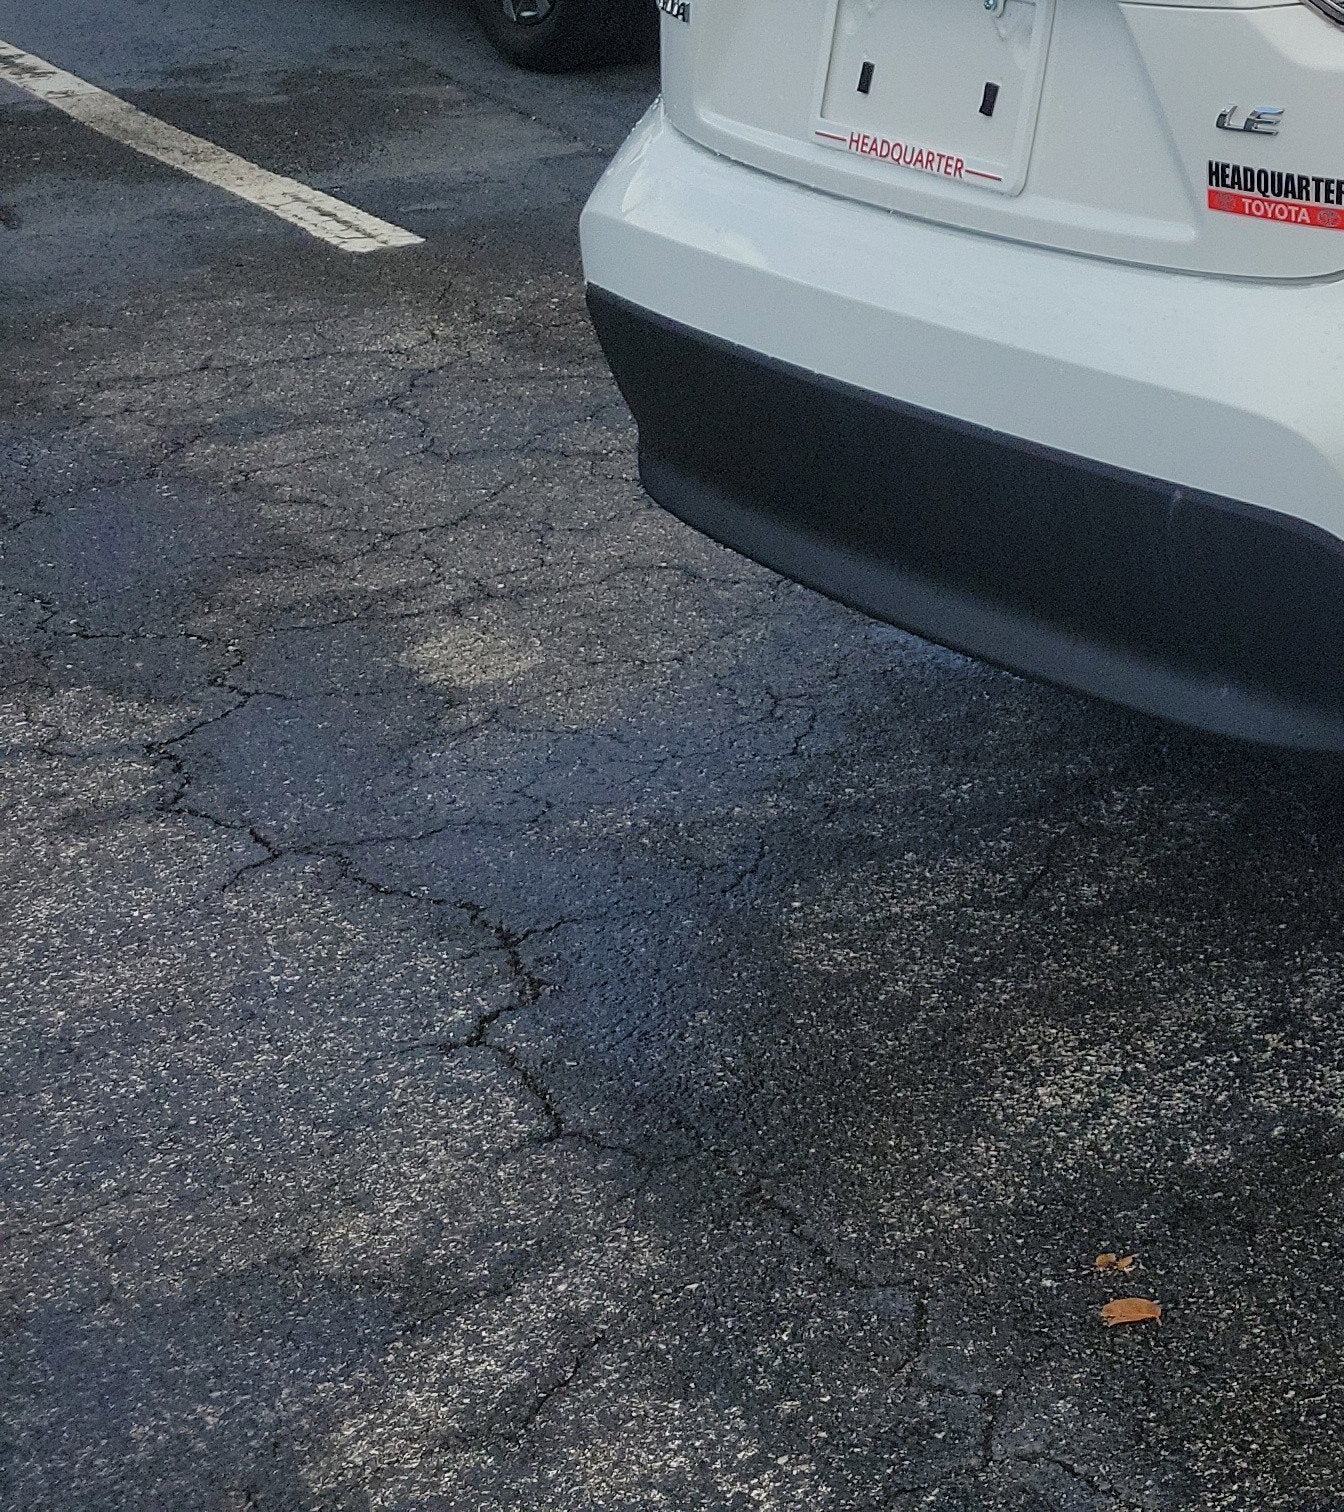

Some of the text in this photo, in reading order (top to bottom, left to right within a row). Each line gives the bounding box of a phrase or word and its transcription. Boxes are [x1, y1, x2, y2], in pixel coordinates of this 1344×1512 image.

[1215, 103, 1285, 136] LE
[848, 131, 965, 179] HEADQUARTER
[1242, 198, 1311, 224] TOYOTA
